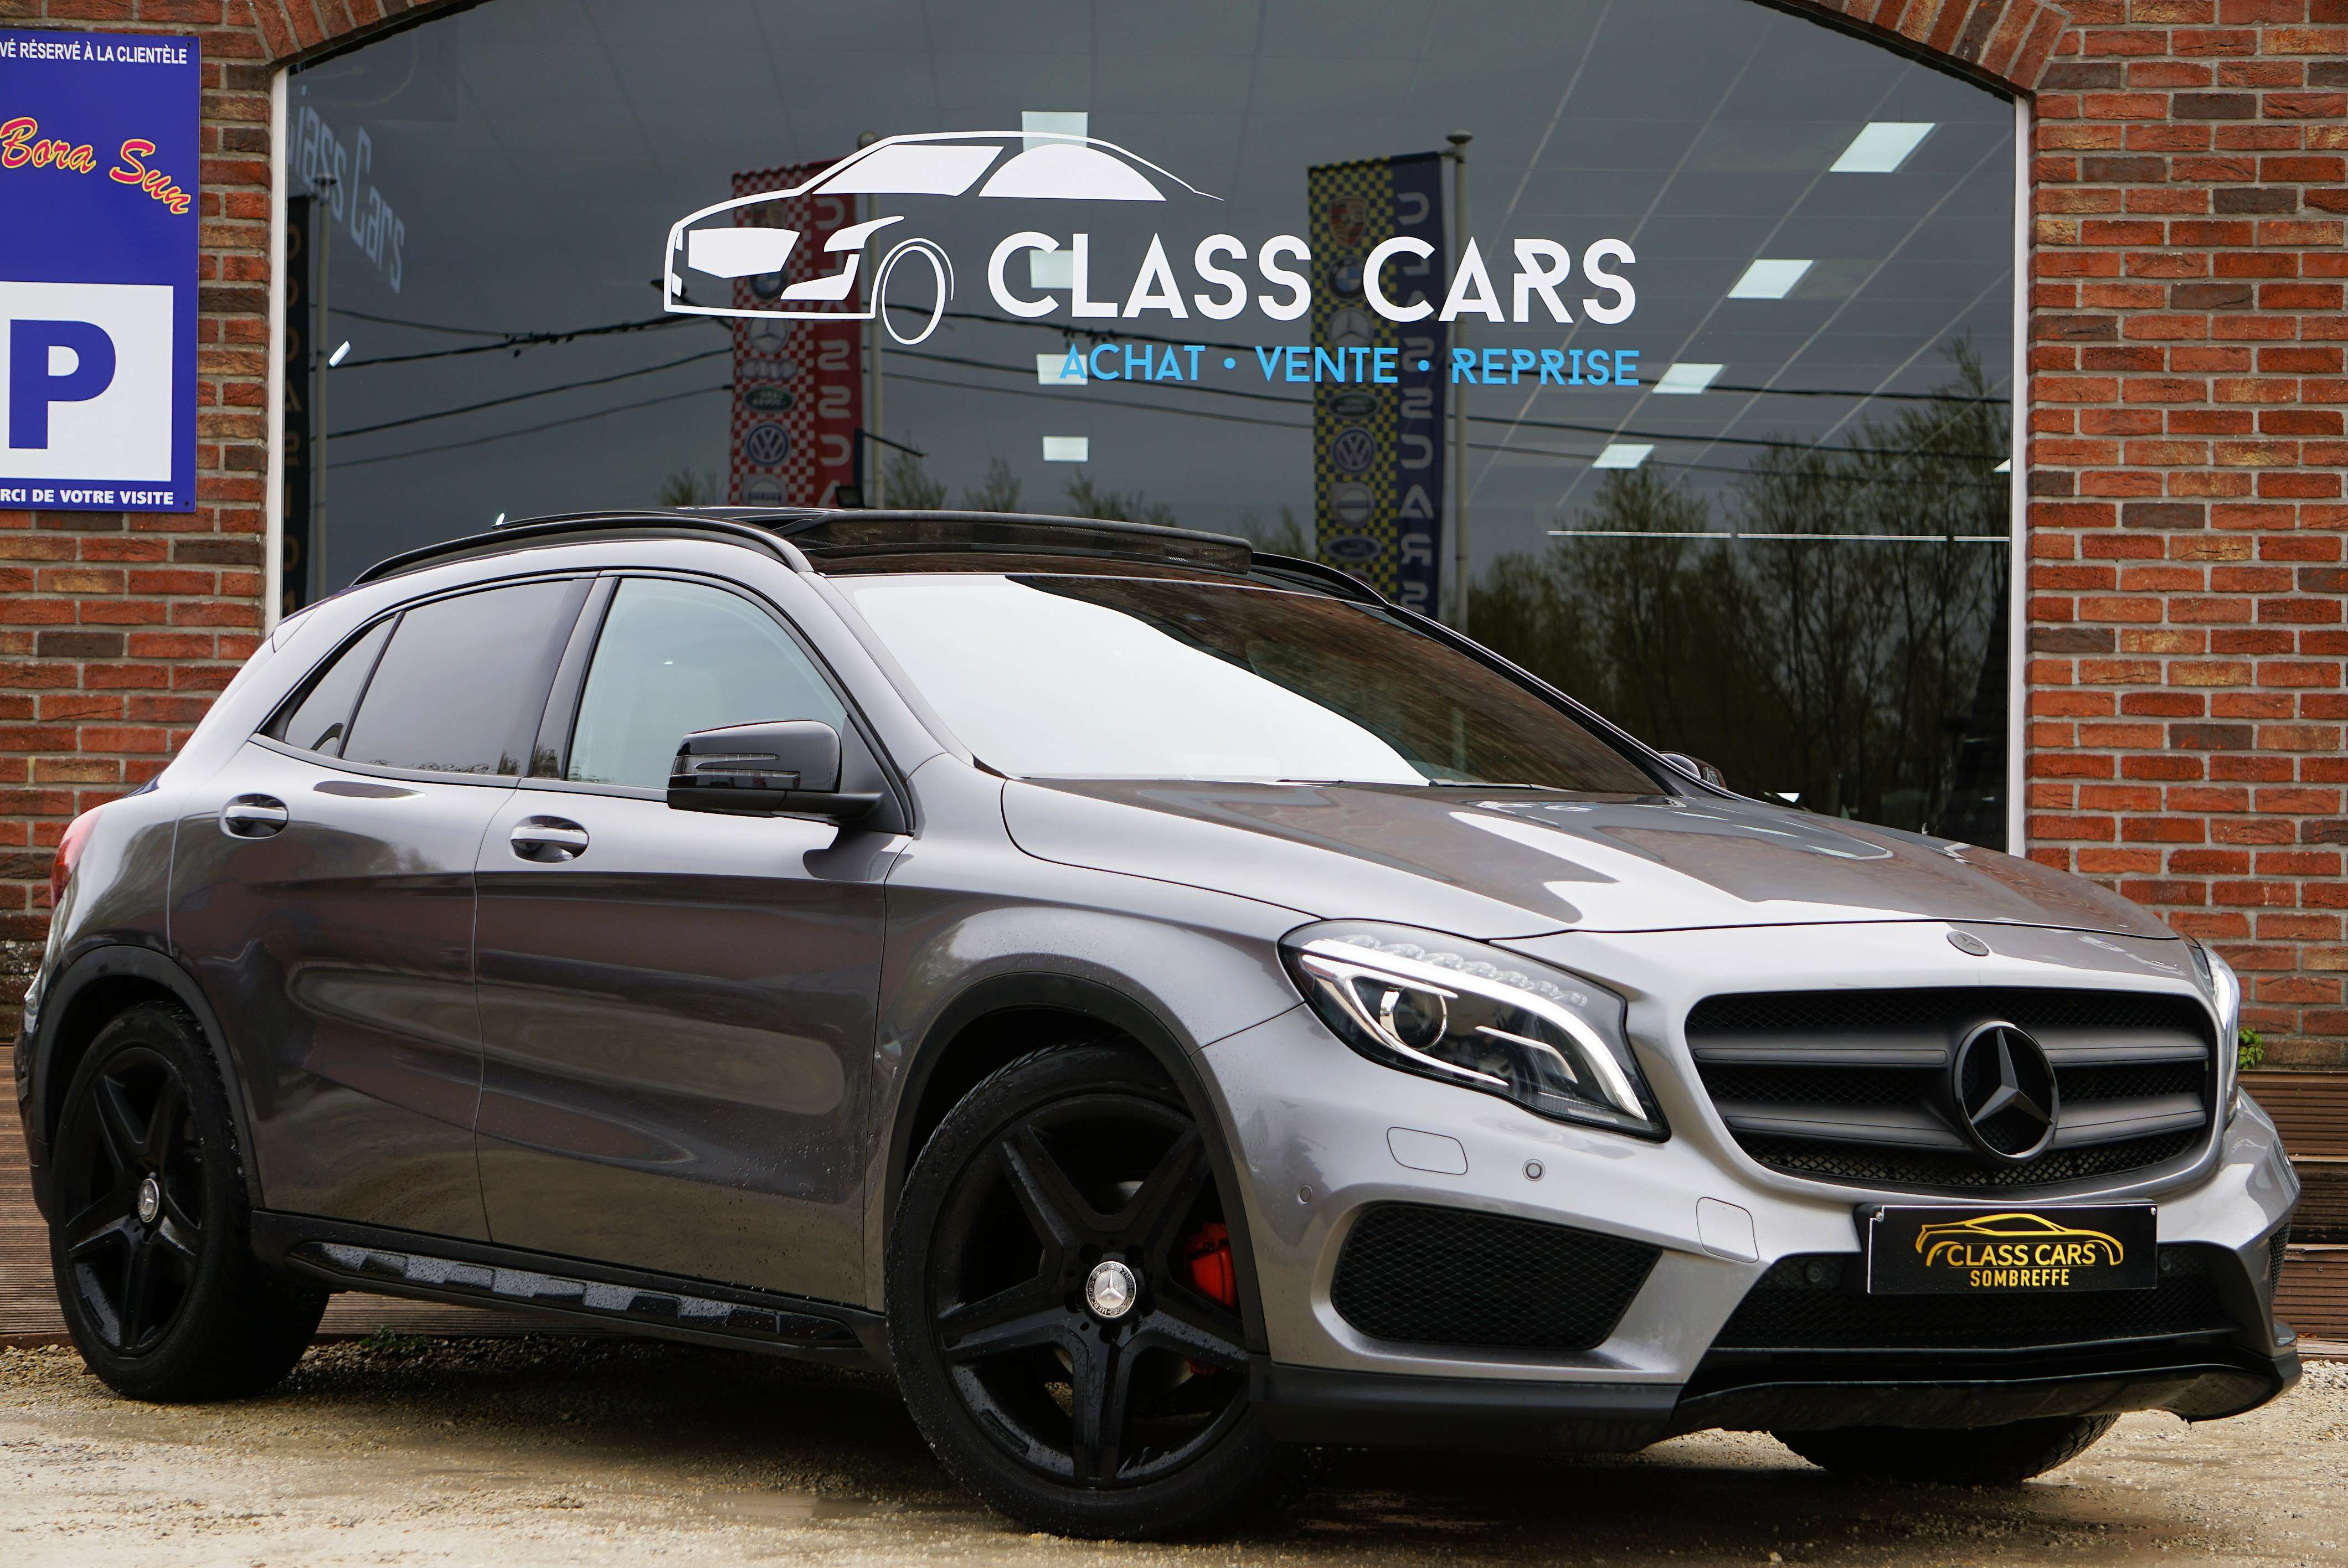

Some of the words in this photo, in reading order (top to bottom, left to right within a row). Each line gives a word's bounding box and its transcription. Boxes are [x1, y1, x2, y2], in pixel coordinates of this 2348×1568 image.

[20, 39, 81, 60] RÉSERVÉ
[84, 41, 94, 61] À
[97, 45, 115, 61] LA
[117, 44, 187, 64] CLIENTÈLE
[0, 116, 96, 174] Bora
[109, 138, 191, 215] Sun
[987, 231, 1311, 321] CLASS
[1363, 236, 1635, 324] CARS
[1059, 344, 1206, 381] ACHAT
[1255, 345, 1398, 383] VENTE
[1452, 348, 1640, 386] REPRISE
[9, 319, 116, 449] P
[32, 489, 55, 503] DE
[60, 489, 115, 504] VOTRE
[120, 491, 174, 506] VISITE
[1947, 1244, 2028, 1266] CLASS
[2035, 1242, 2096, 1266] CARS
[1970, 1268, 2070, 1287] SOMBREFFE
